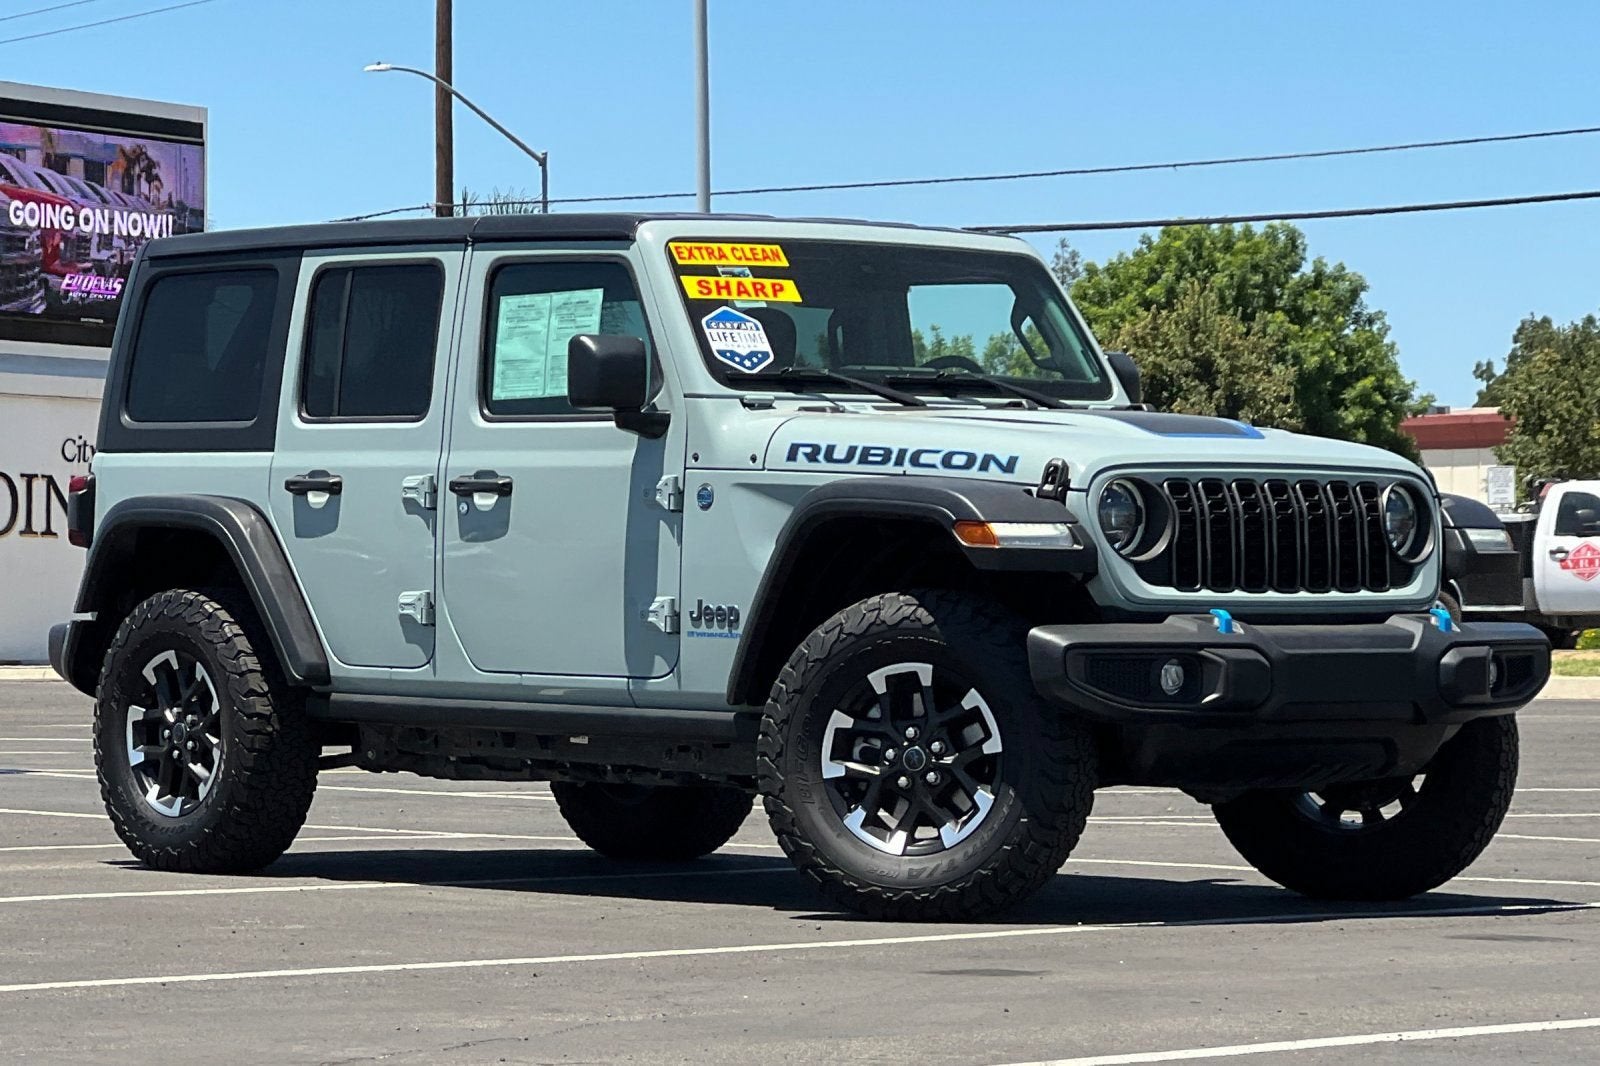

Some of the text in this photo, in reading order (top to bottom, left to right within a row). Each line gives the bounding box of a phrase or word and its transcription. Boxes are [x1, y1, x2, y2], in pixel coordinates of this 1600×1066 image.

[9, 200, 173, 239] GOING ON NOW!!
[674, 246, 783, 262] EXTRA CLEAN
[696, 279, 785, 299] SHARP
[708, 331, 766, 344] LIFETIME
[786, 442, 1020, 475] RUBICON
[688, 598, 741, 629] Jeep
